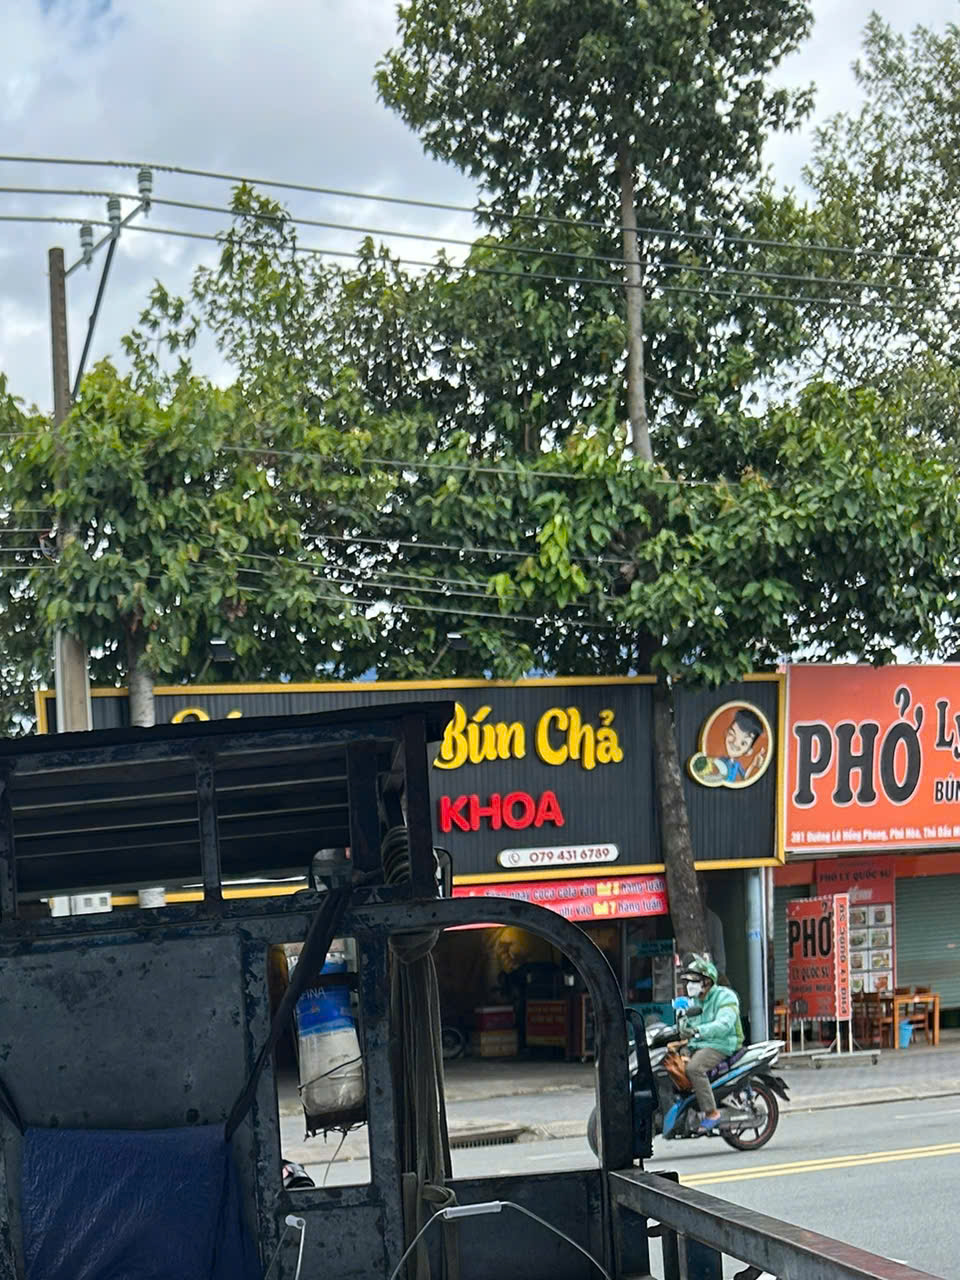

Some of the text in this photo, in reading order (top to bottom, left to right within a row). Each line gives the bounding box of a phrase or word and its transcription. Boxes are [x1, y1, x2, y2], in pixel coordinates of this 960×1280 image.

[433, 702, 625, 771] Bún Chả
[793, 686, 924, 806] PHỞ
[439, 790, 566, 833] KHOA
[529, 847, 610, 864] 079 431 6789
[789, 902, 833, 960] PHỞ
